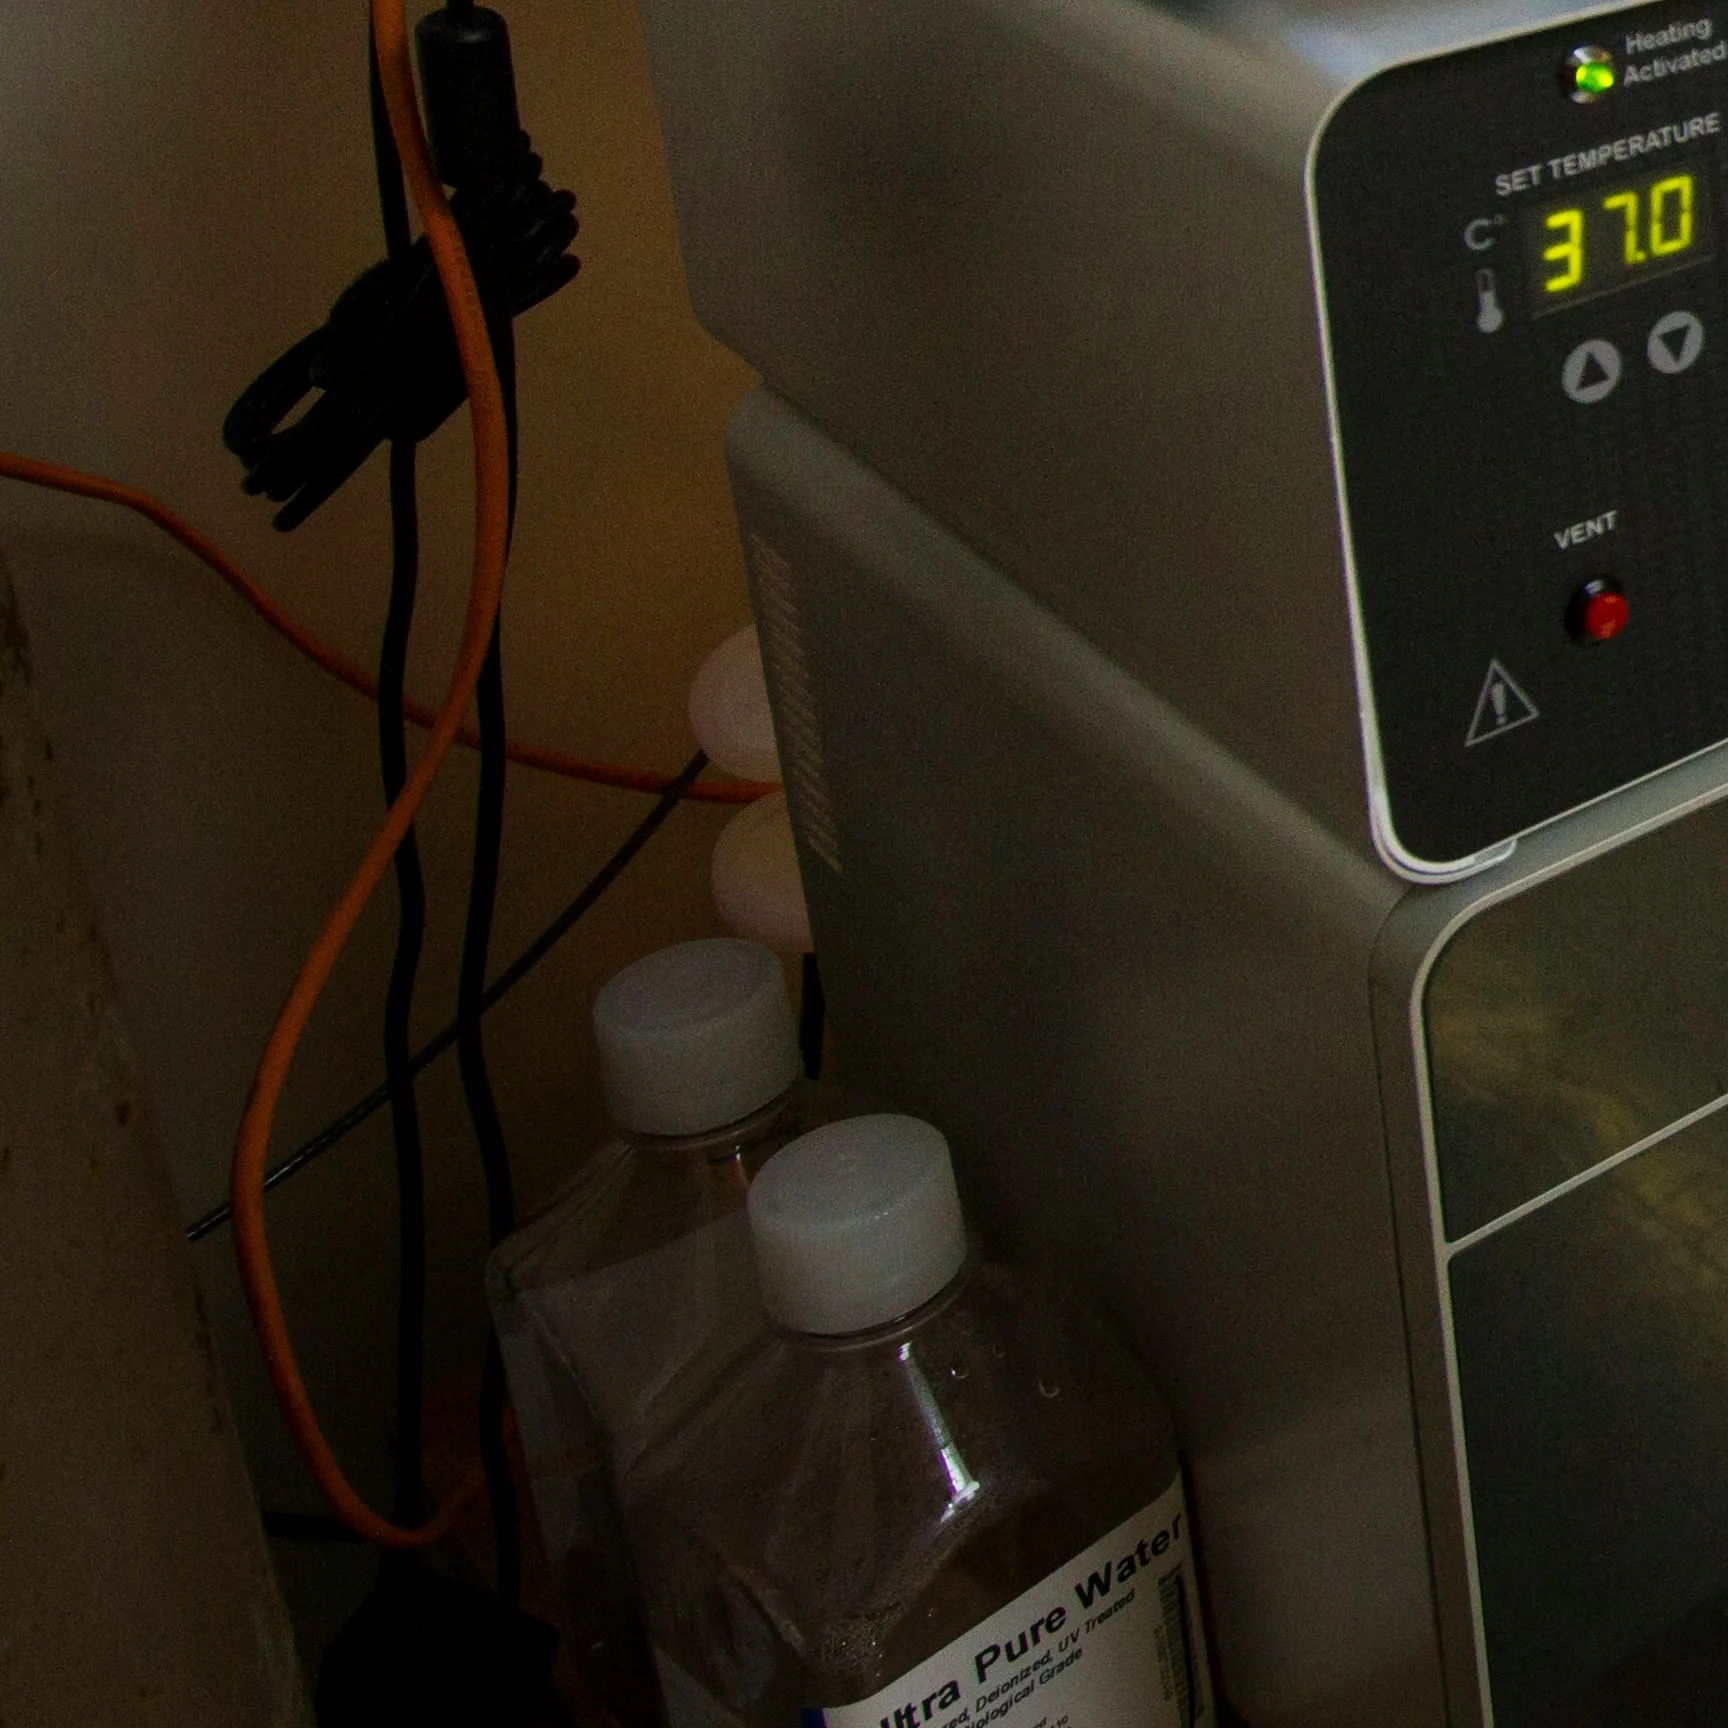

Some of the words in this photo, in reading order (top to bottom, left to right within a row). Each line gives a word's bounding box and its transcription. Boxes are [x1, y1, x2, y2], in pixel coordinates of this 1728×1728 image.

[1625, 14, 1713, 55] Heating
[1494, 161, 1543, 199] SET
[1546, 110, 1722, 184] TEMPERATURE
[1541, 174, 1694, 294] 37.0
[1552, 508, 1619, 553] VENT
[880, 1679, 961, 1728] ltra
[975, 1604, 1068, 1684] Pure
[1074, 1510, 1182, 1610] Water
[1057, 1627, 1080, 1653] UV
[1084, 1586, 1136, 1636] Treated
[1038, 1647, 1084, 1685] Grade
